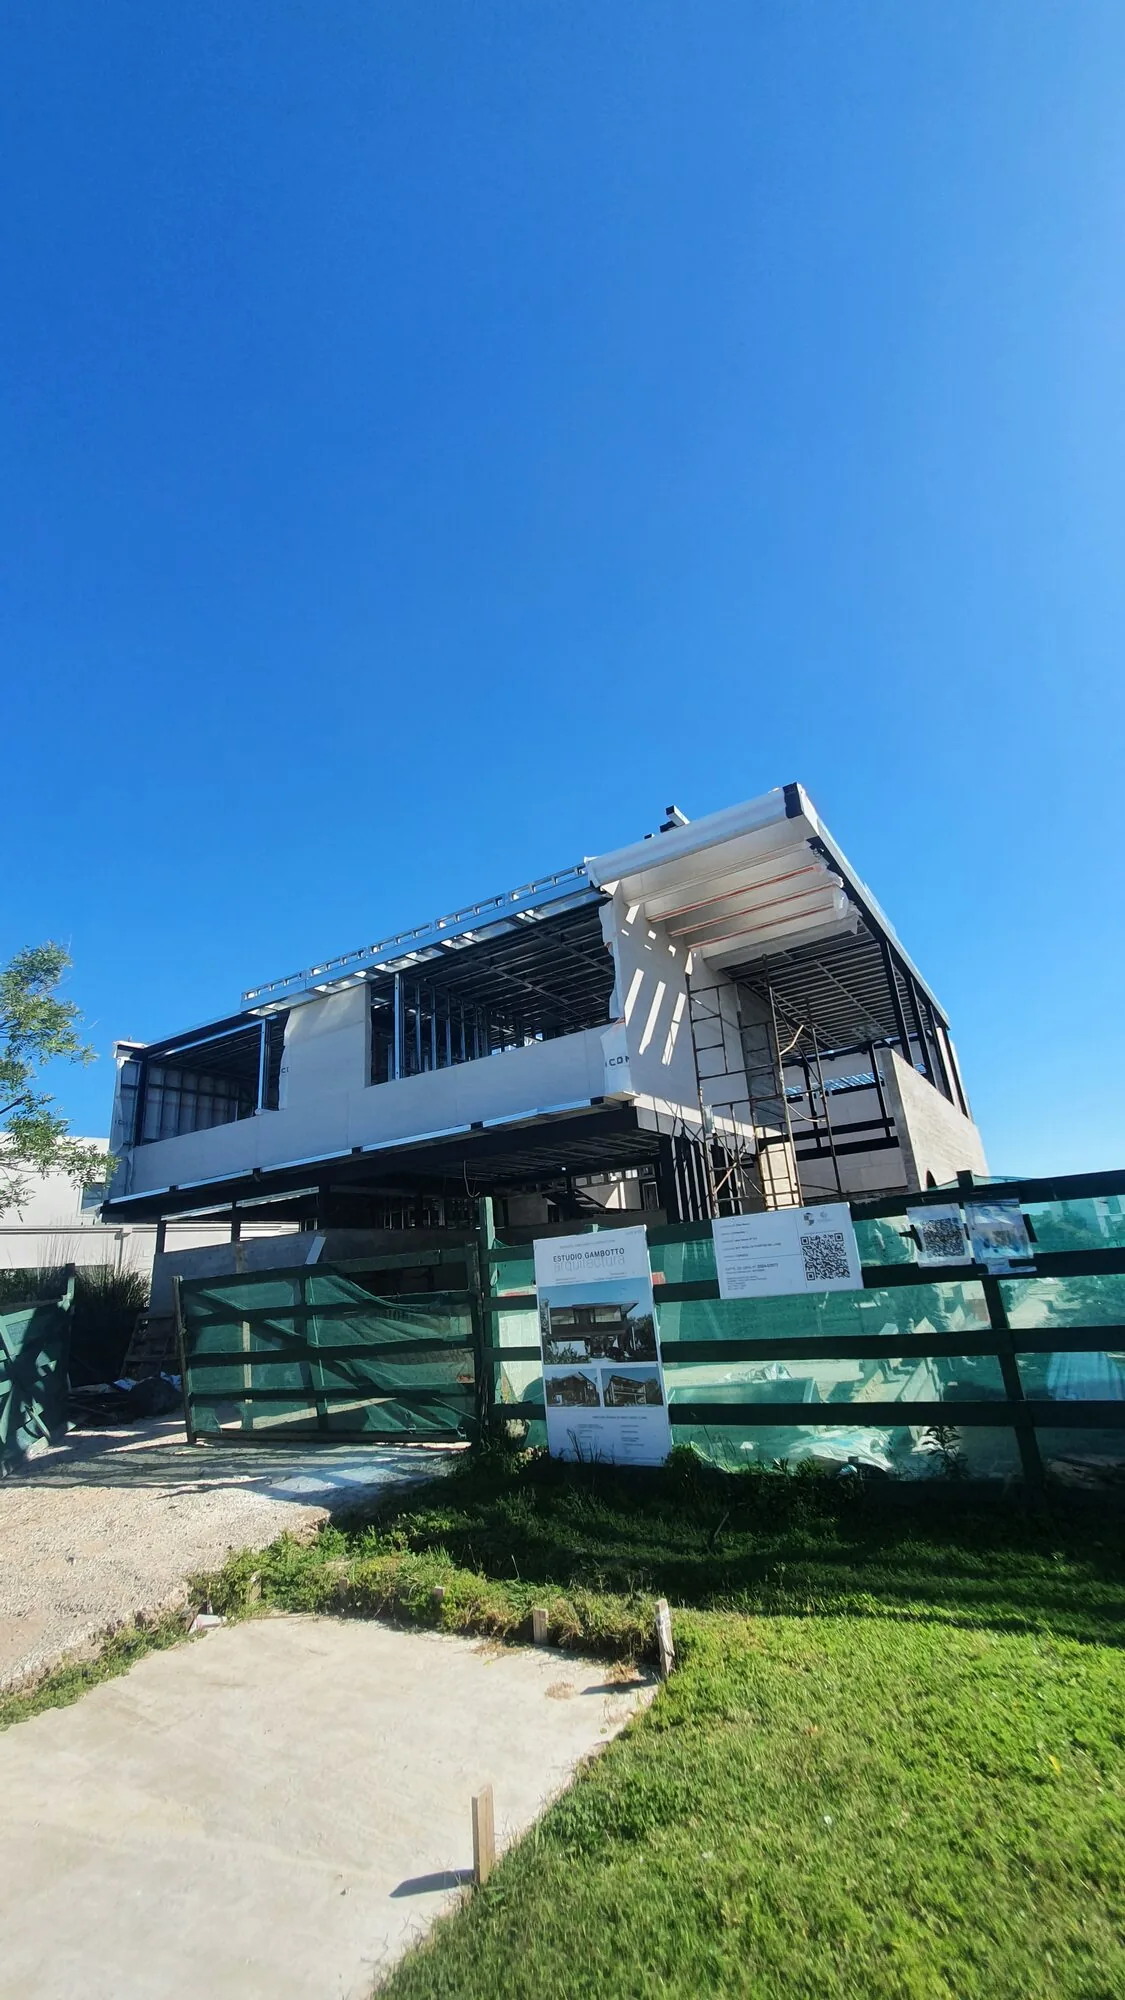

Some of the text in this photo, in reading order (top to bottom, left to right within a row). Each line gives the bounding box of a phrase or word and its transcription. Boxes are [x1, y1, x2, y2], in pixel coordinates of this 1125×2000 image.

[553, 1247, 625, 1263] ESTUDIO GAMBOTTO
[554, 1255, 625, 1272] arquitectura
